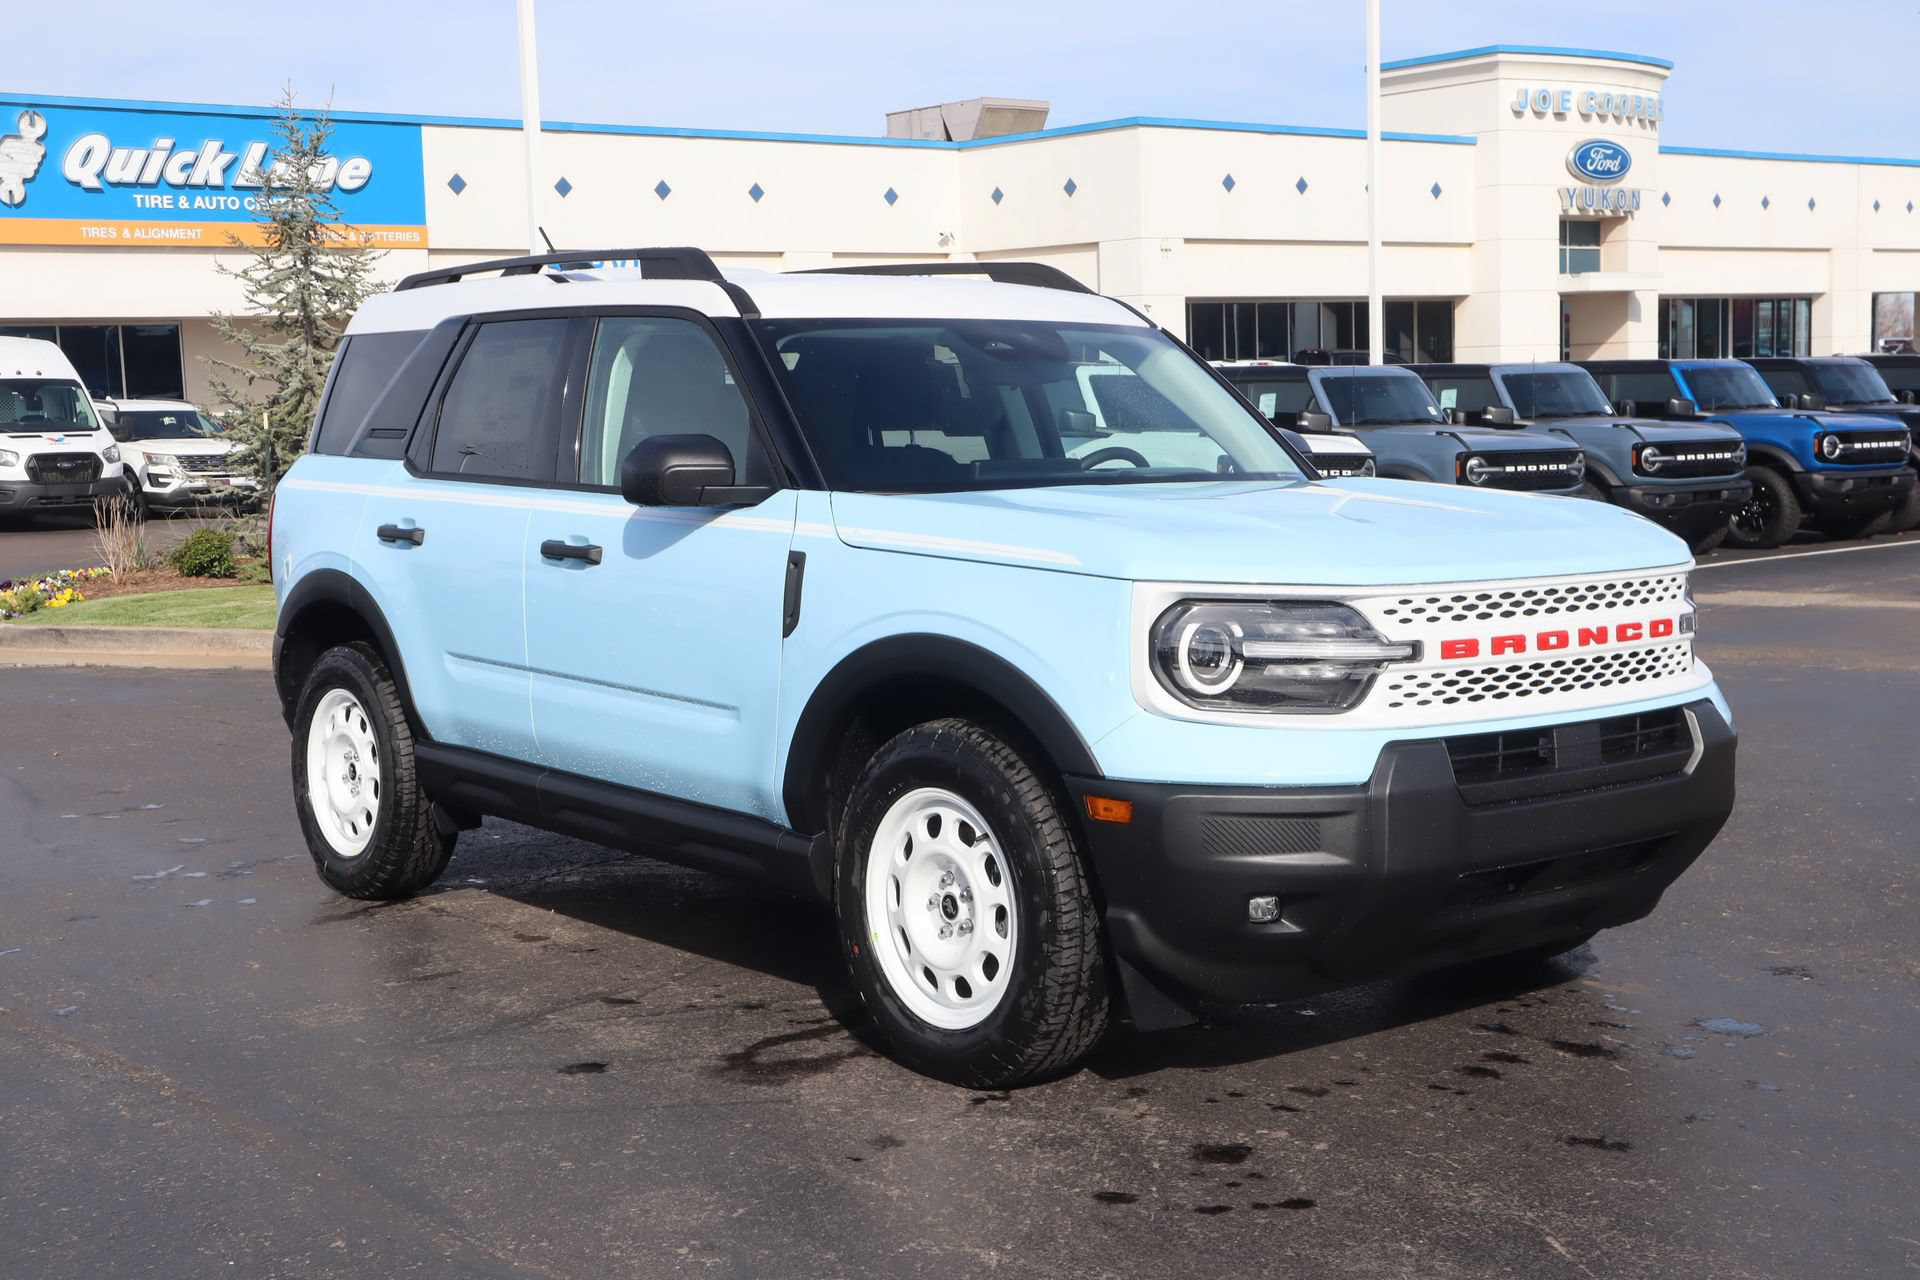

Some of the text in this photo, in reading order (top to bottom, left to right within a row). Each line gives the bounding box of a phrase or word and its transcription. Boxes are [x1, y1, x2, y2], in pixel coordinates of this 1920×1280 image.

[1514, 88, 1664, 120] JOE COOPER
[62, 132, 238, 189] Quick
[1586, 147, 1621, 172] Ford
[133, 194, 174, 208] TIRE
[179, 195, 190, 209] &
[194, 197, 240, 210] AUTO
[1564, 187, 1640, 210] YUKON
[80, 227, 203, 240] TIRES & ALIGNMENT
[1504, 464, 1567, 472] BRONCO
[1441, 618, 1673, 660] BRONCO
